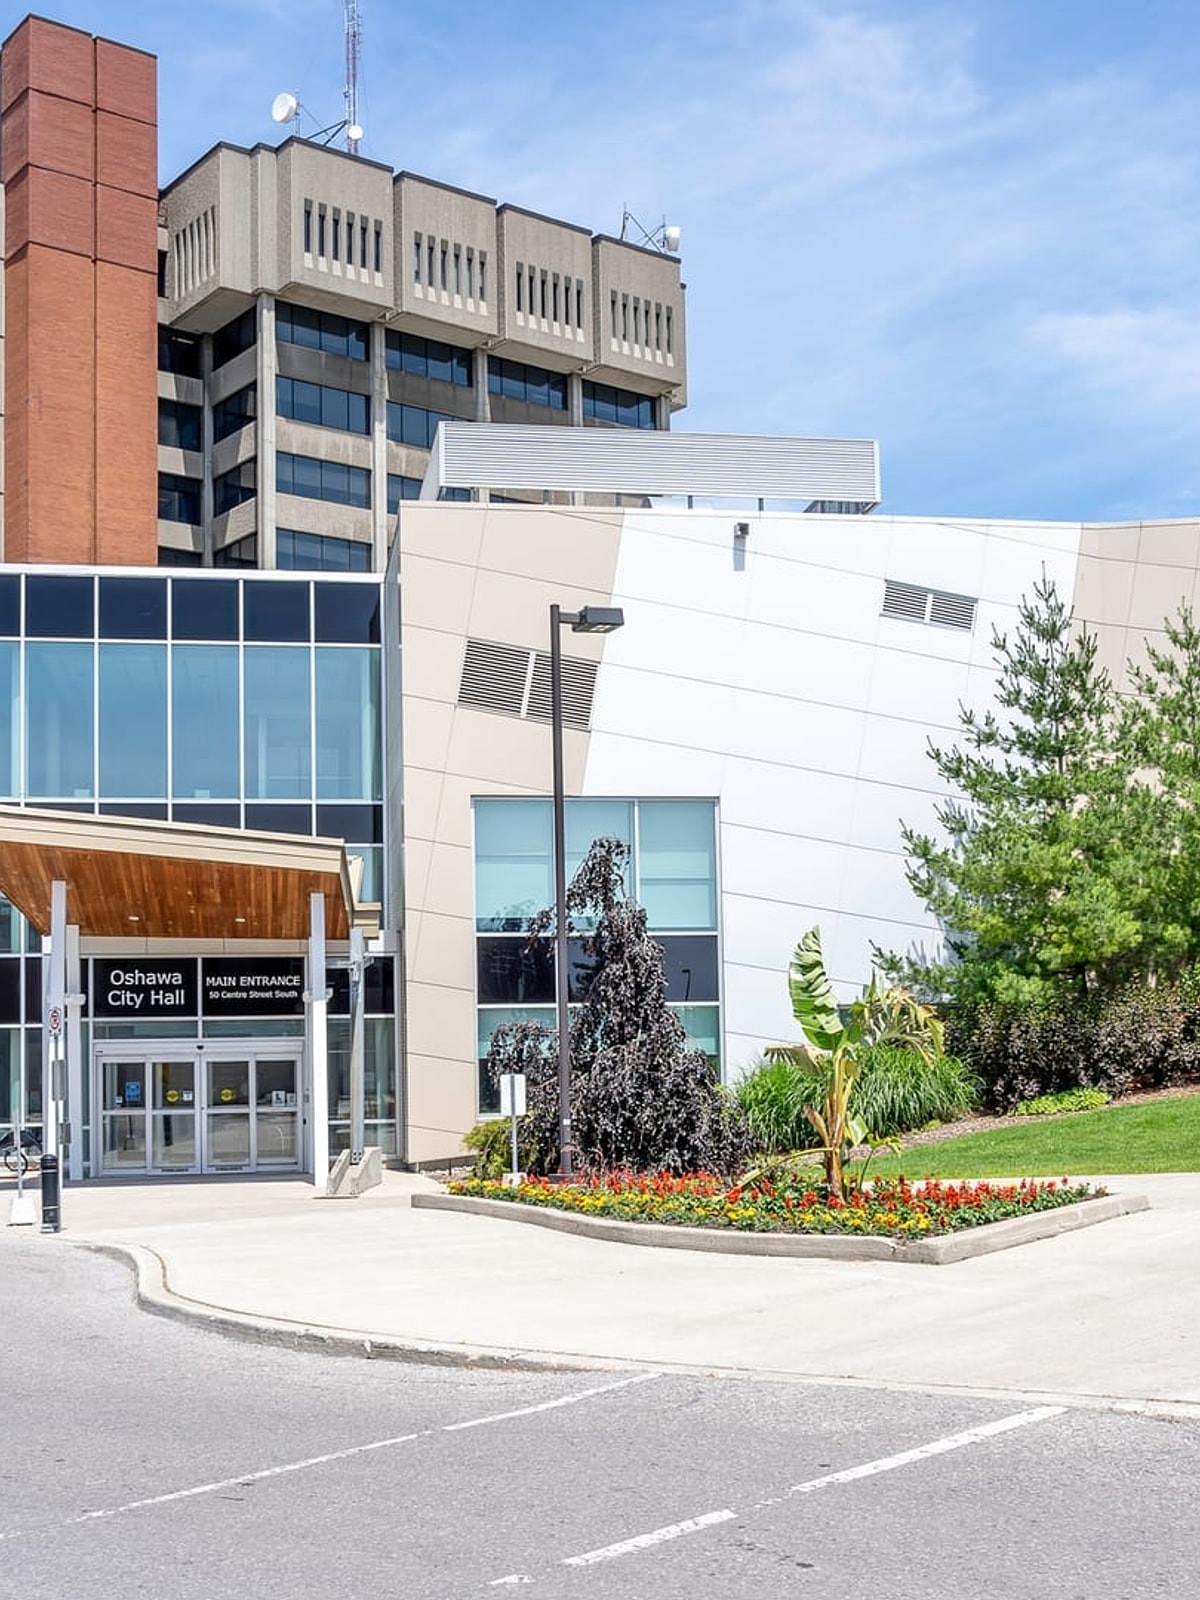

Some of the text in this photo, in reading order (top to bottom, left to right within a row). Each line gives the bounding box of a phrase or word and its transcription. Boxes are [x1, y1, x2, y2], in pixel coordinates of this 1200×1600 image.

[110, 969, 182, 985] Oshawa
[206, 976, 300, 986] MAIN ENTRANCE
[108, 990, 185, 1008] City Hall
[209, 991, 219, 999] 50
[275, 990, 298, 998] South
